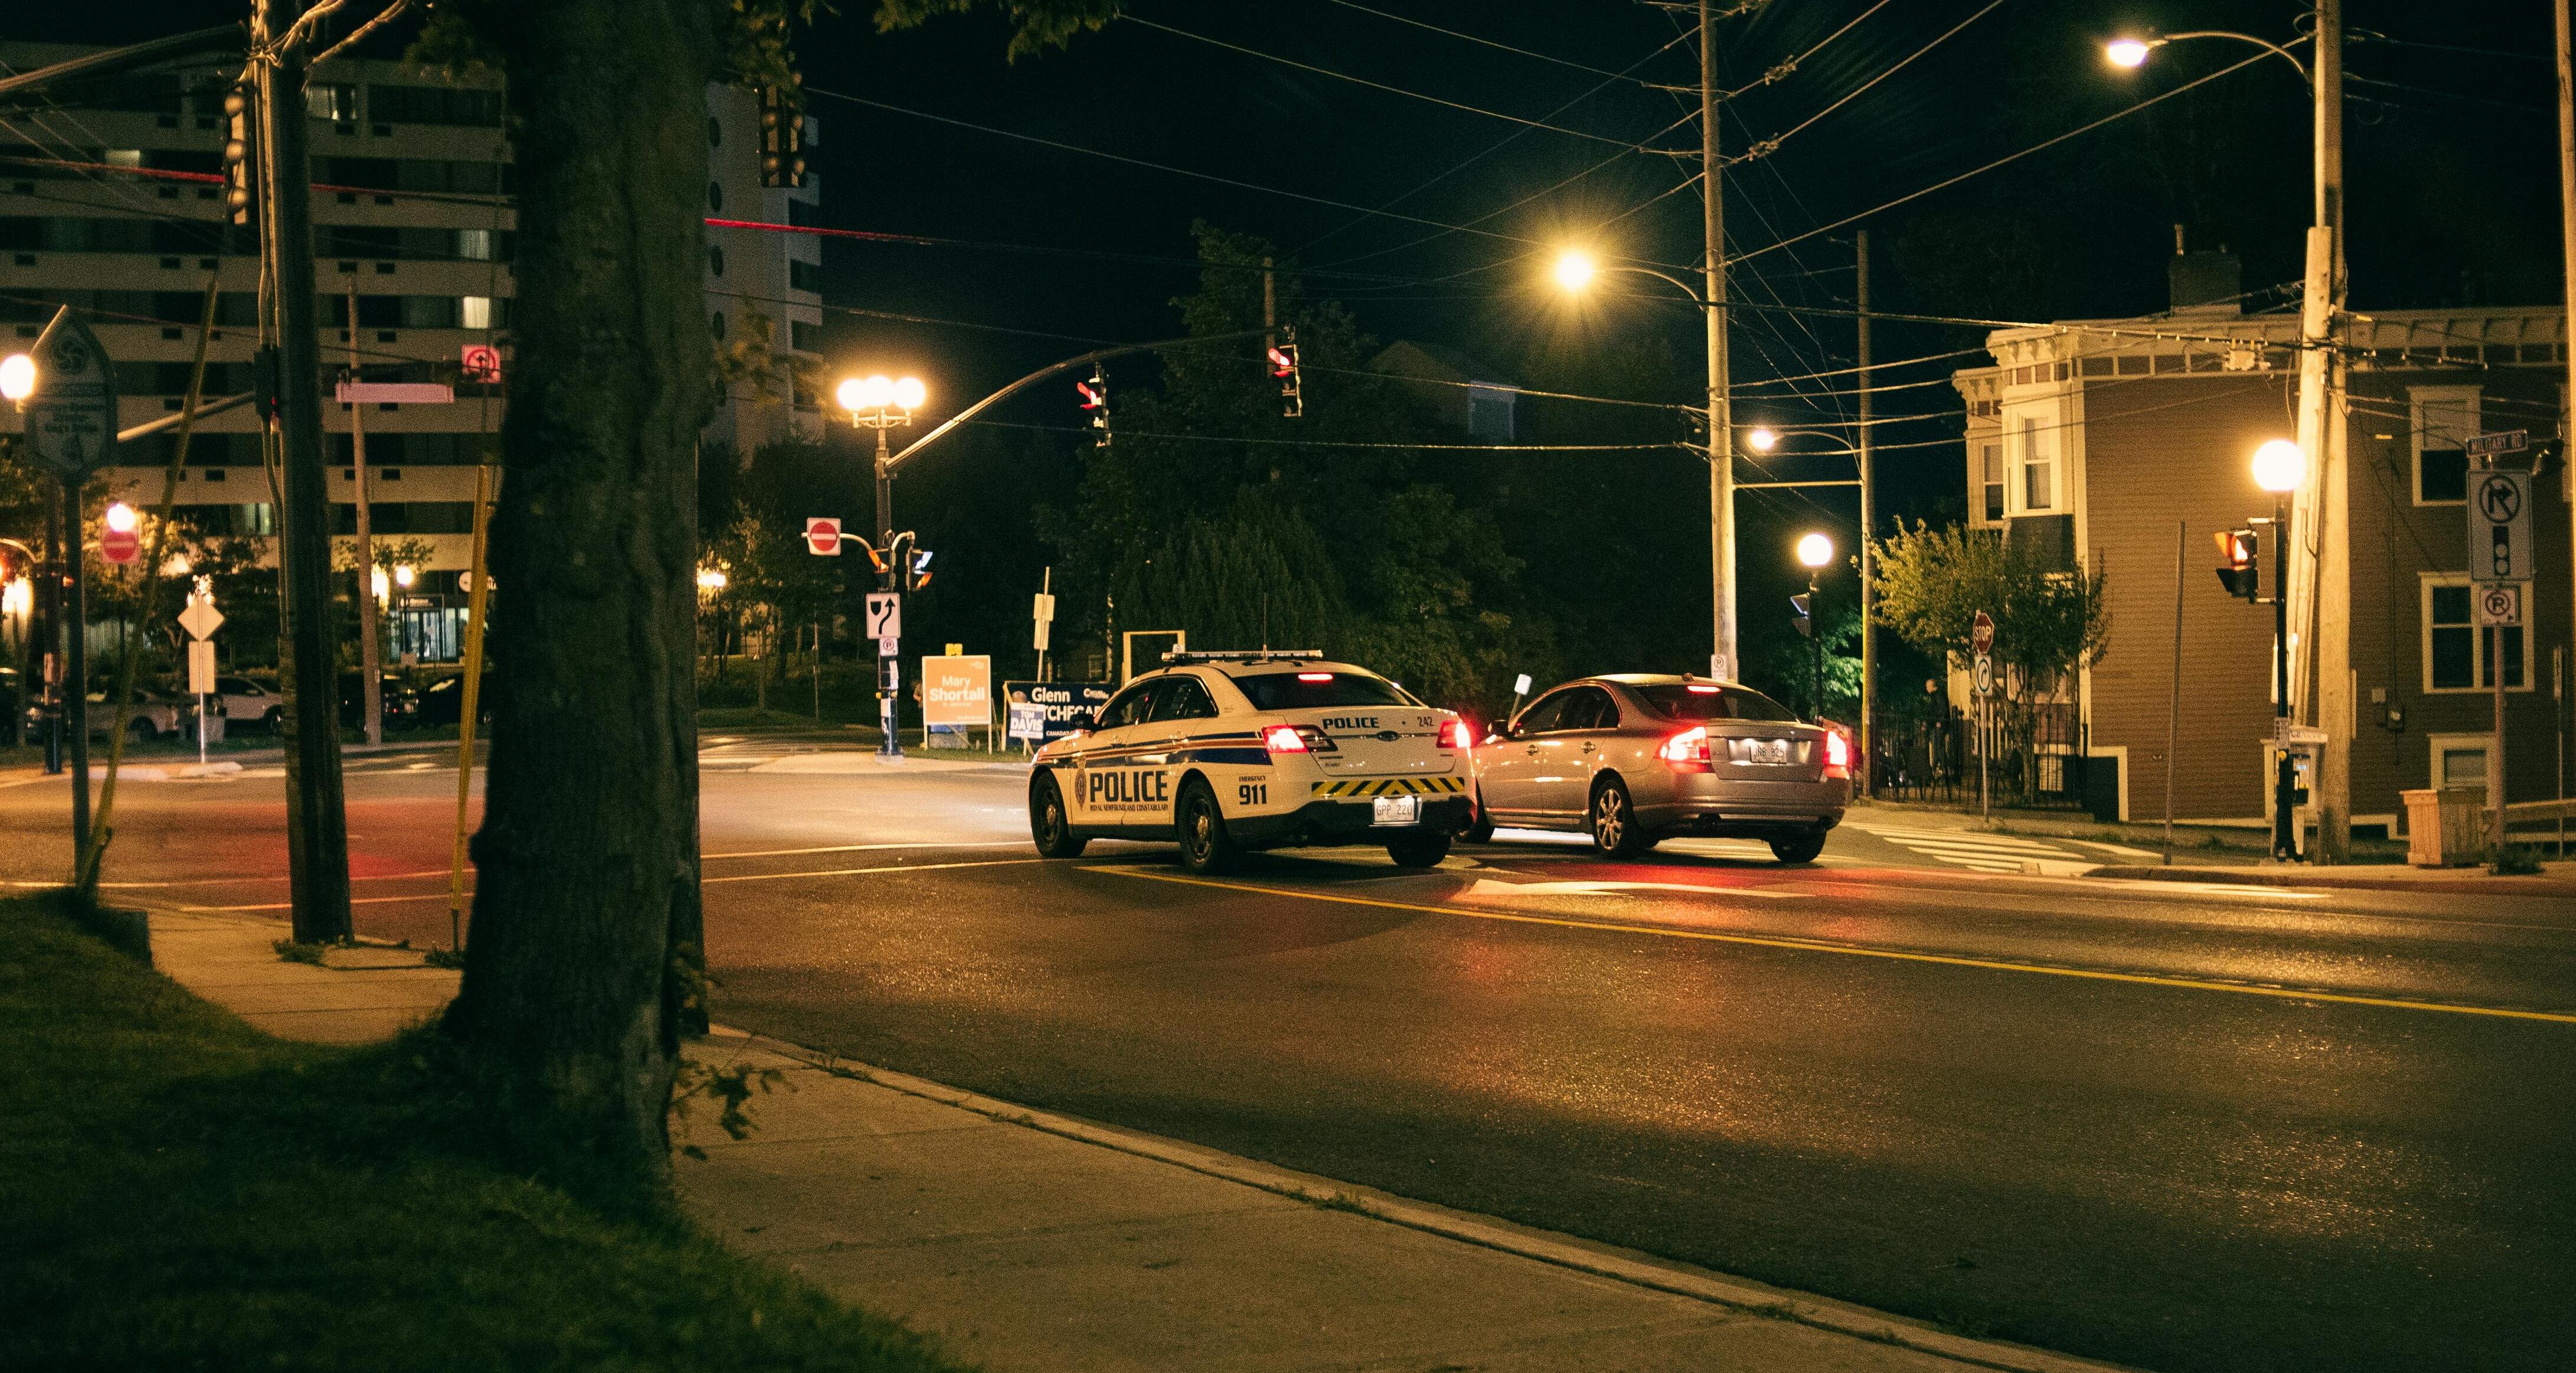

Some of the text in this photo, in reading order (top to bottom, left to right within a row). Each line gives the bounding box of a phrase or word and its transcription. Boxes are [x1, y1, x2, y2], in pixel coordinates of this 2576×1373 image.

[2471, 435, 2506, 454] MILITARY
[1974, 625, 1991, 642] STOP
[942, 675, 972, 689] Mary
[929, 686, 985, 702] Shortall
[1031, 687, 1070, 703] Glenn
[1020, 710, 1034, 719] TOM
[1417, 716, 1434, 727] 242
[1011, 717, 1043, 731] DAVIS
[1322, 717, 1380, 729] POLICE
[1090, 771, 1168, 803] POLICE
[1239, 784, 1267, 805] 911
[1376, 804, 1412, 816] GPP 220
